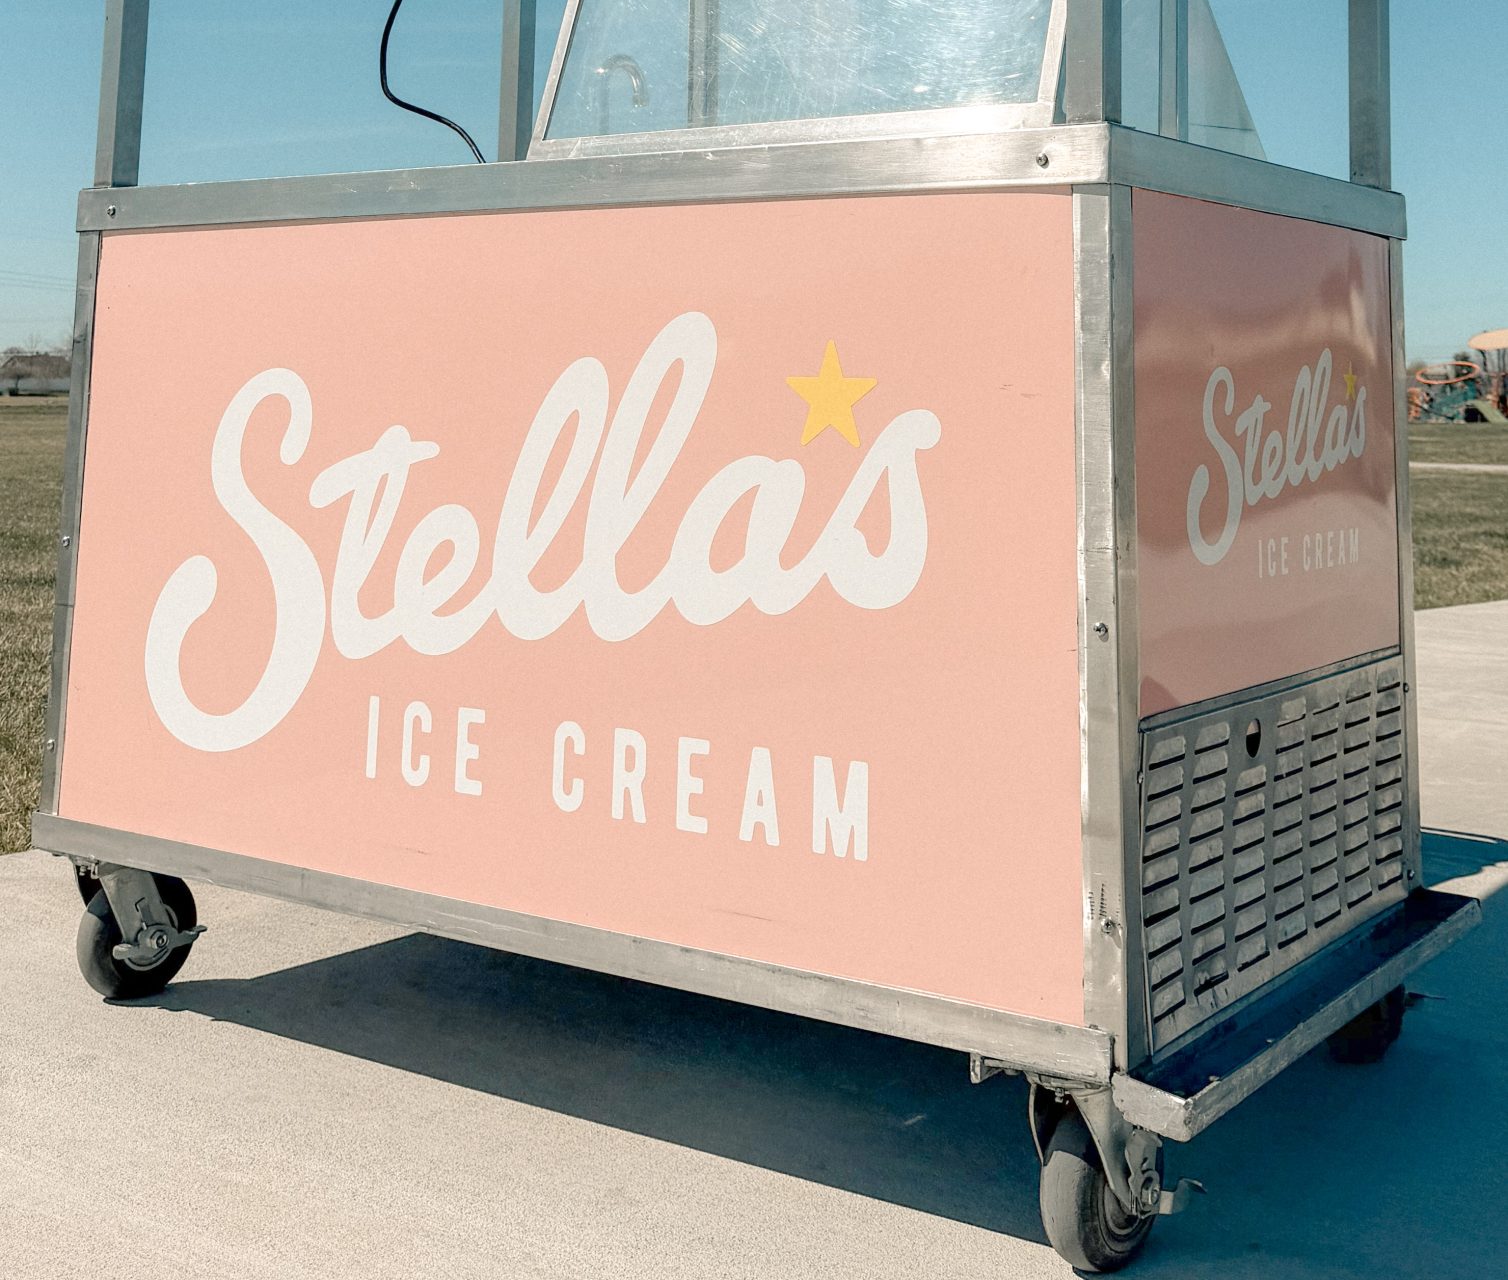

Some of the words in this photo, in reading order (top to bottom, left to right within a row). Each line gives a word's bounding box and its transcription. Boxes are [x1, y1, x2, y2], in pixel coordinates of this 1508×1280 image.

[1258, 536, 1290, 579] ICE
[1303, 528, 1360, 572] CREAM
[365, 695, 486, 796] ICE
[552, 720, 869, 862] CREAM
